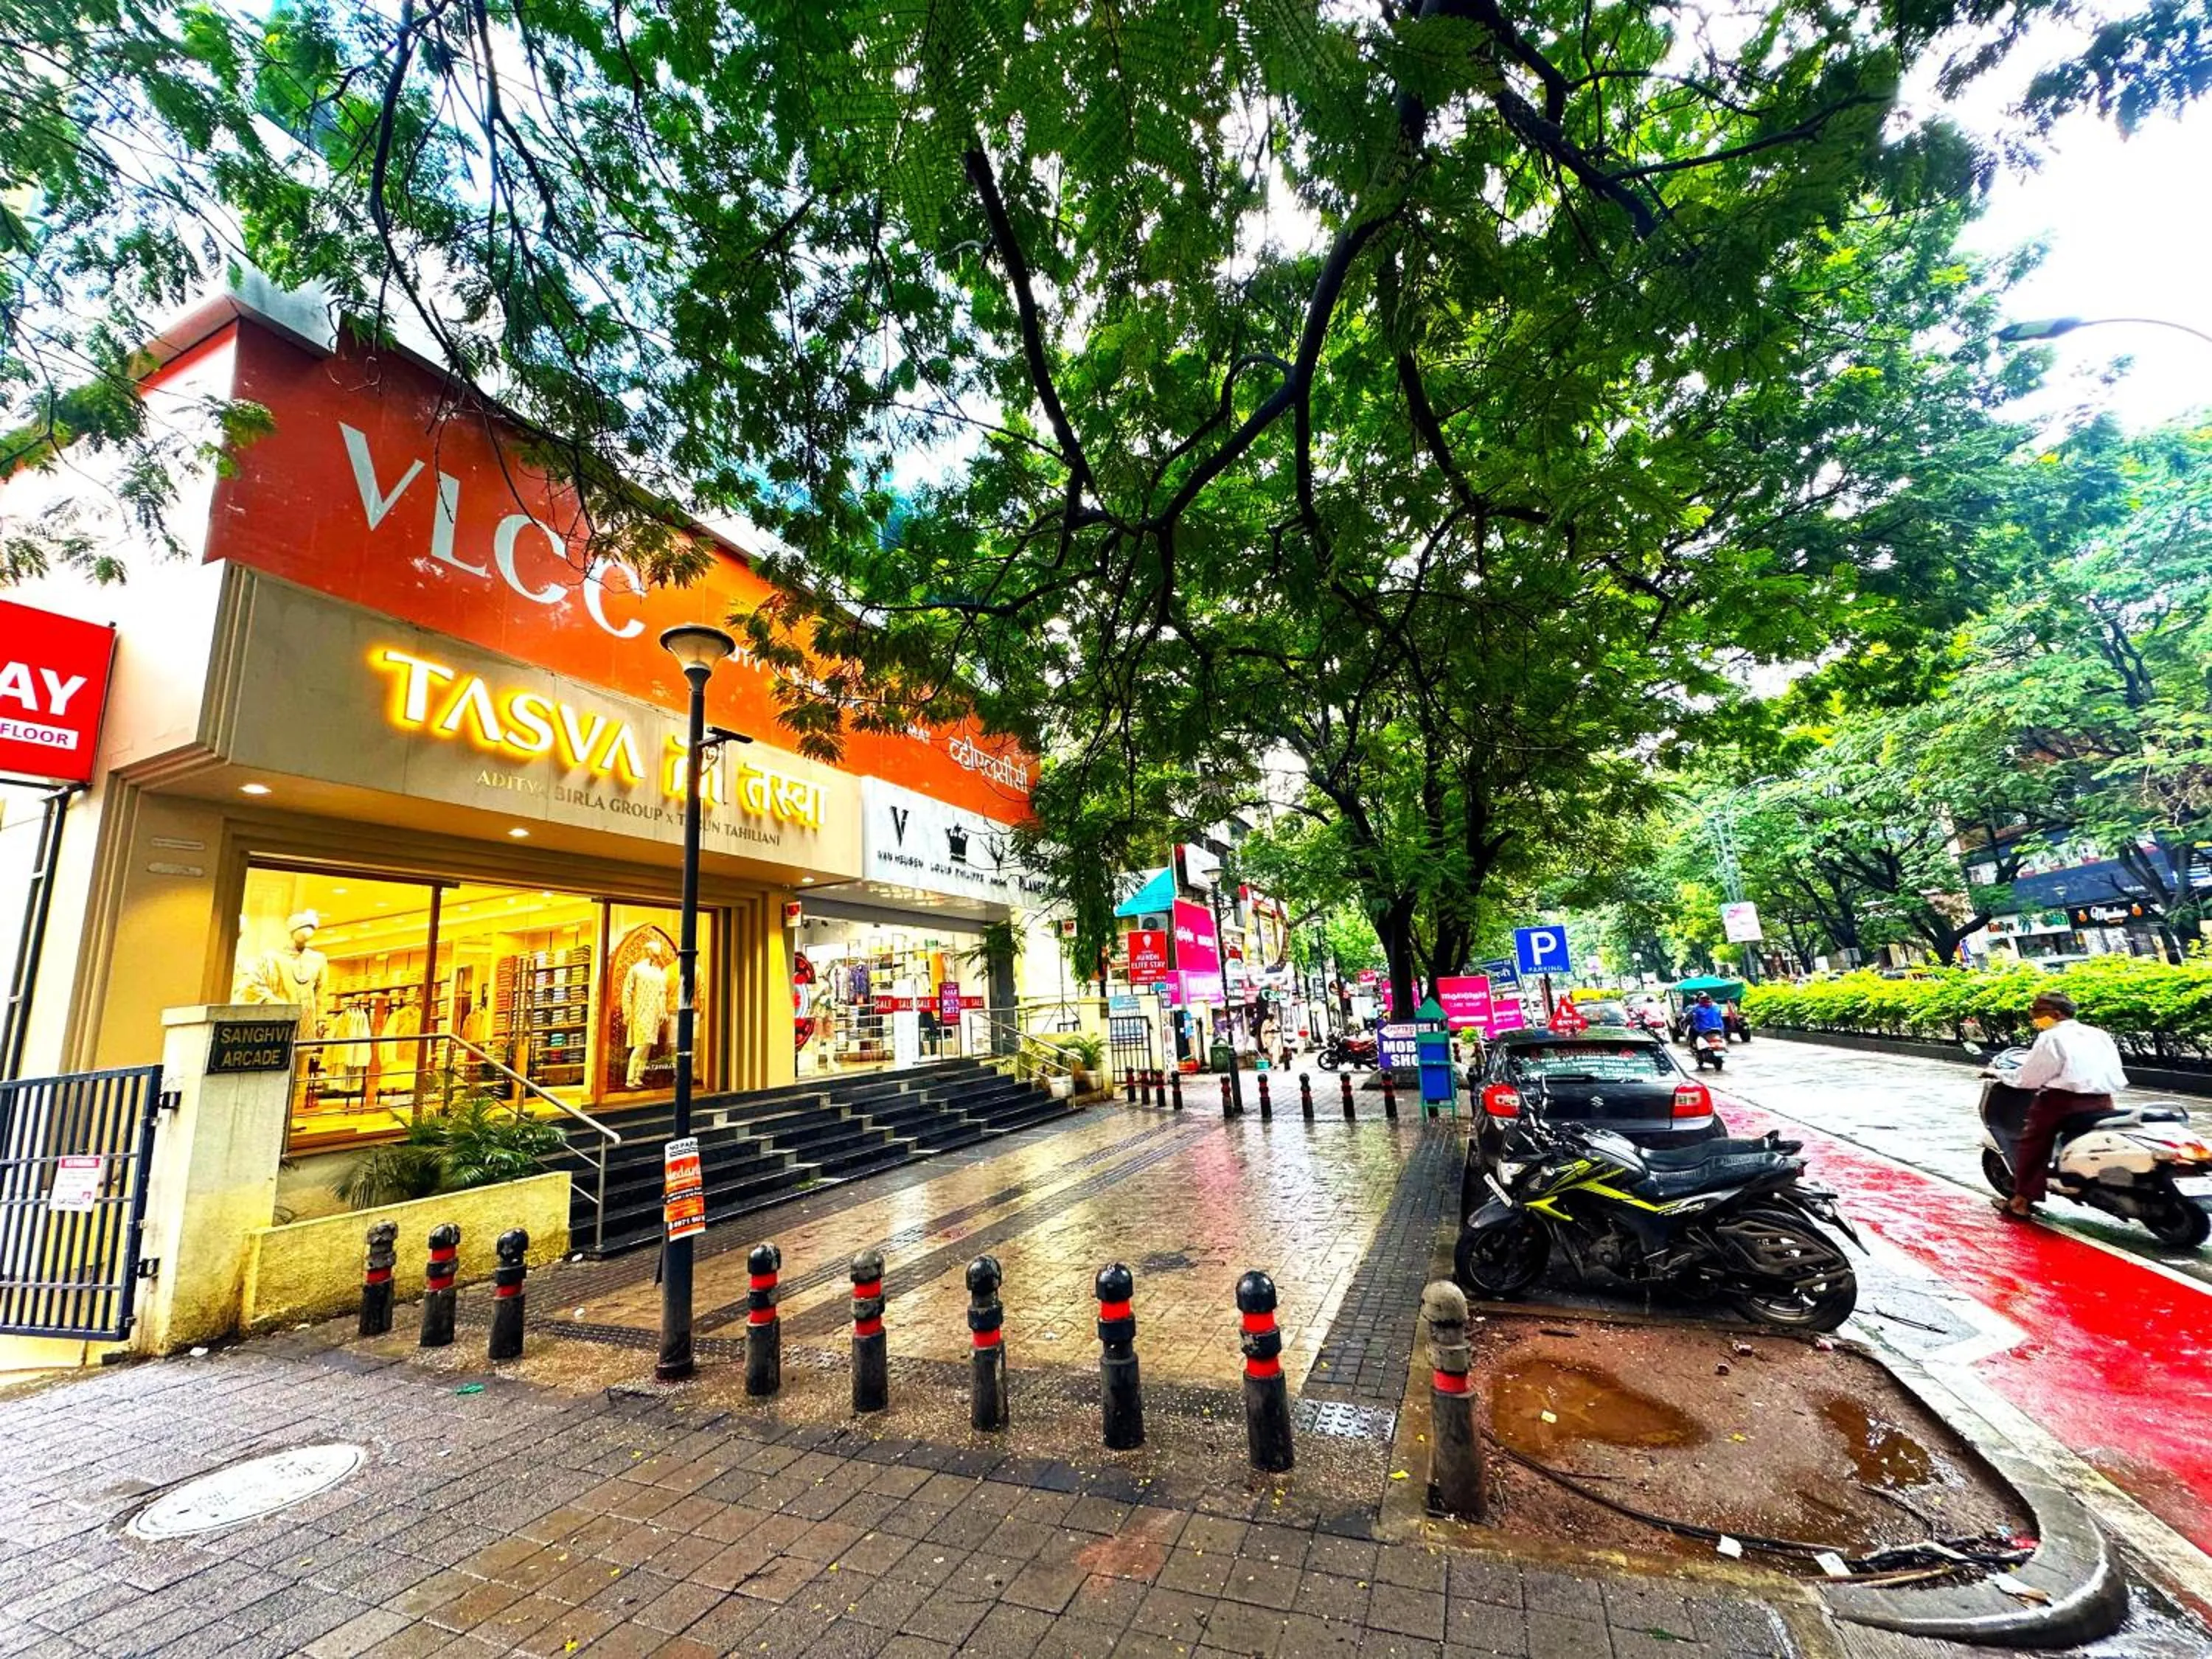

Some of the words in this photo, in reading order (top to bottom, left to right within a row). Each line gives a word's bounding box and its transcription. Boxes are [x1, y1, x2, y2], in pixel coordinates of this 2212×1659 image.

[338, 421, 647, 638] VLCC
[384, 650, 645, 779] TASVA
[0, 723, 69, 745] FLOOR
[742, 762, 830, 824] तस्वा
[477, 769, 544, 799] ADITY
[609, 798, 663, 821] GROUP
[677, 813, 720, 834] TRUN
[724, 824, 780, 846] TAHILIANI
[1530, 931, 1557, 965] P
[875, 1000, 892, 1010] SALE
[220, 1026, 291, 1044] SANGHVI
[1382, 1040, 1416, 1053] MOB
[221, 1049, 281, 1067] ARCADE
[1390, 1054, 1419, 1067] SHO
